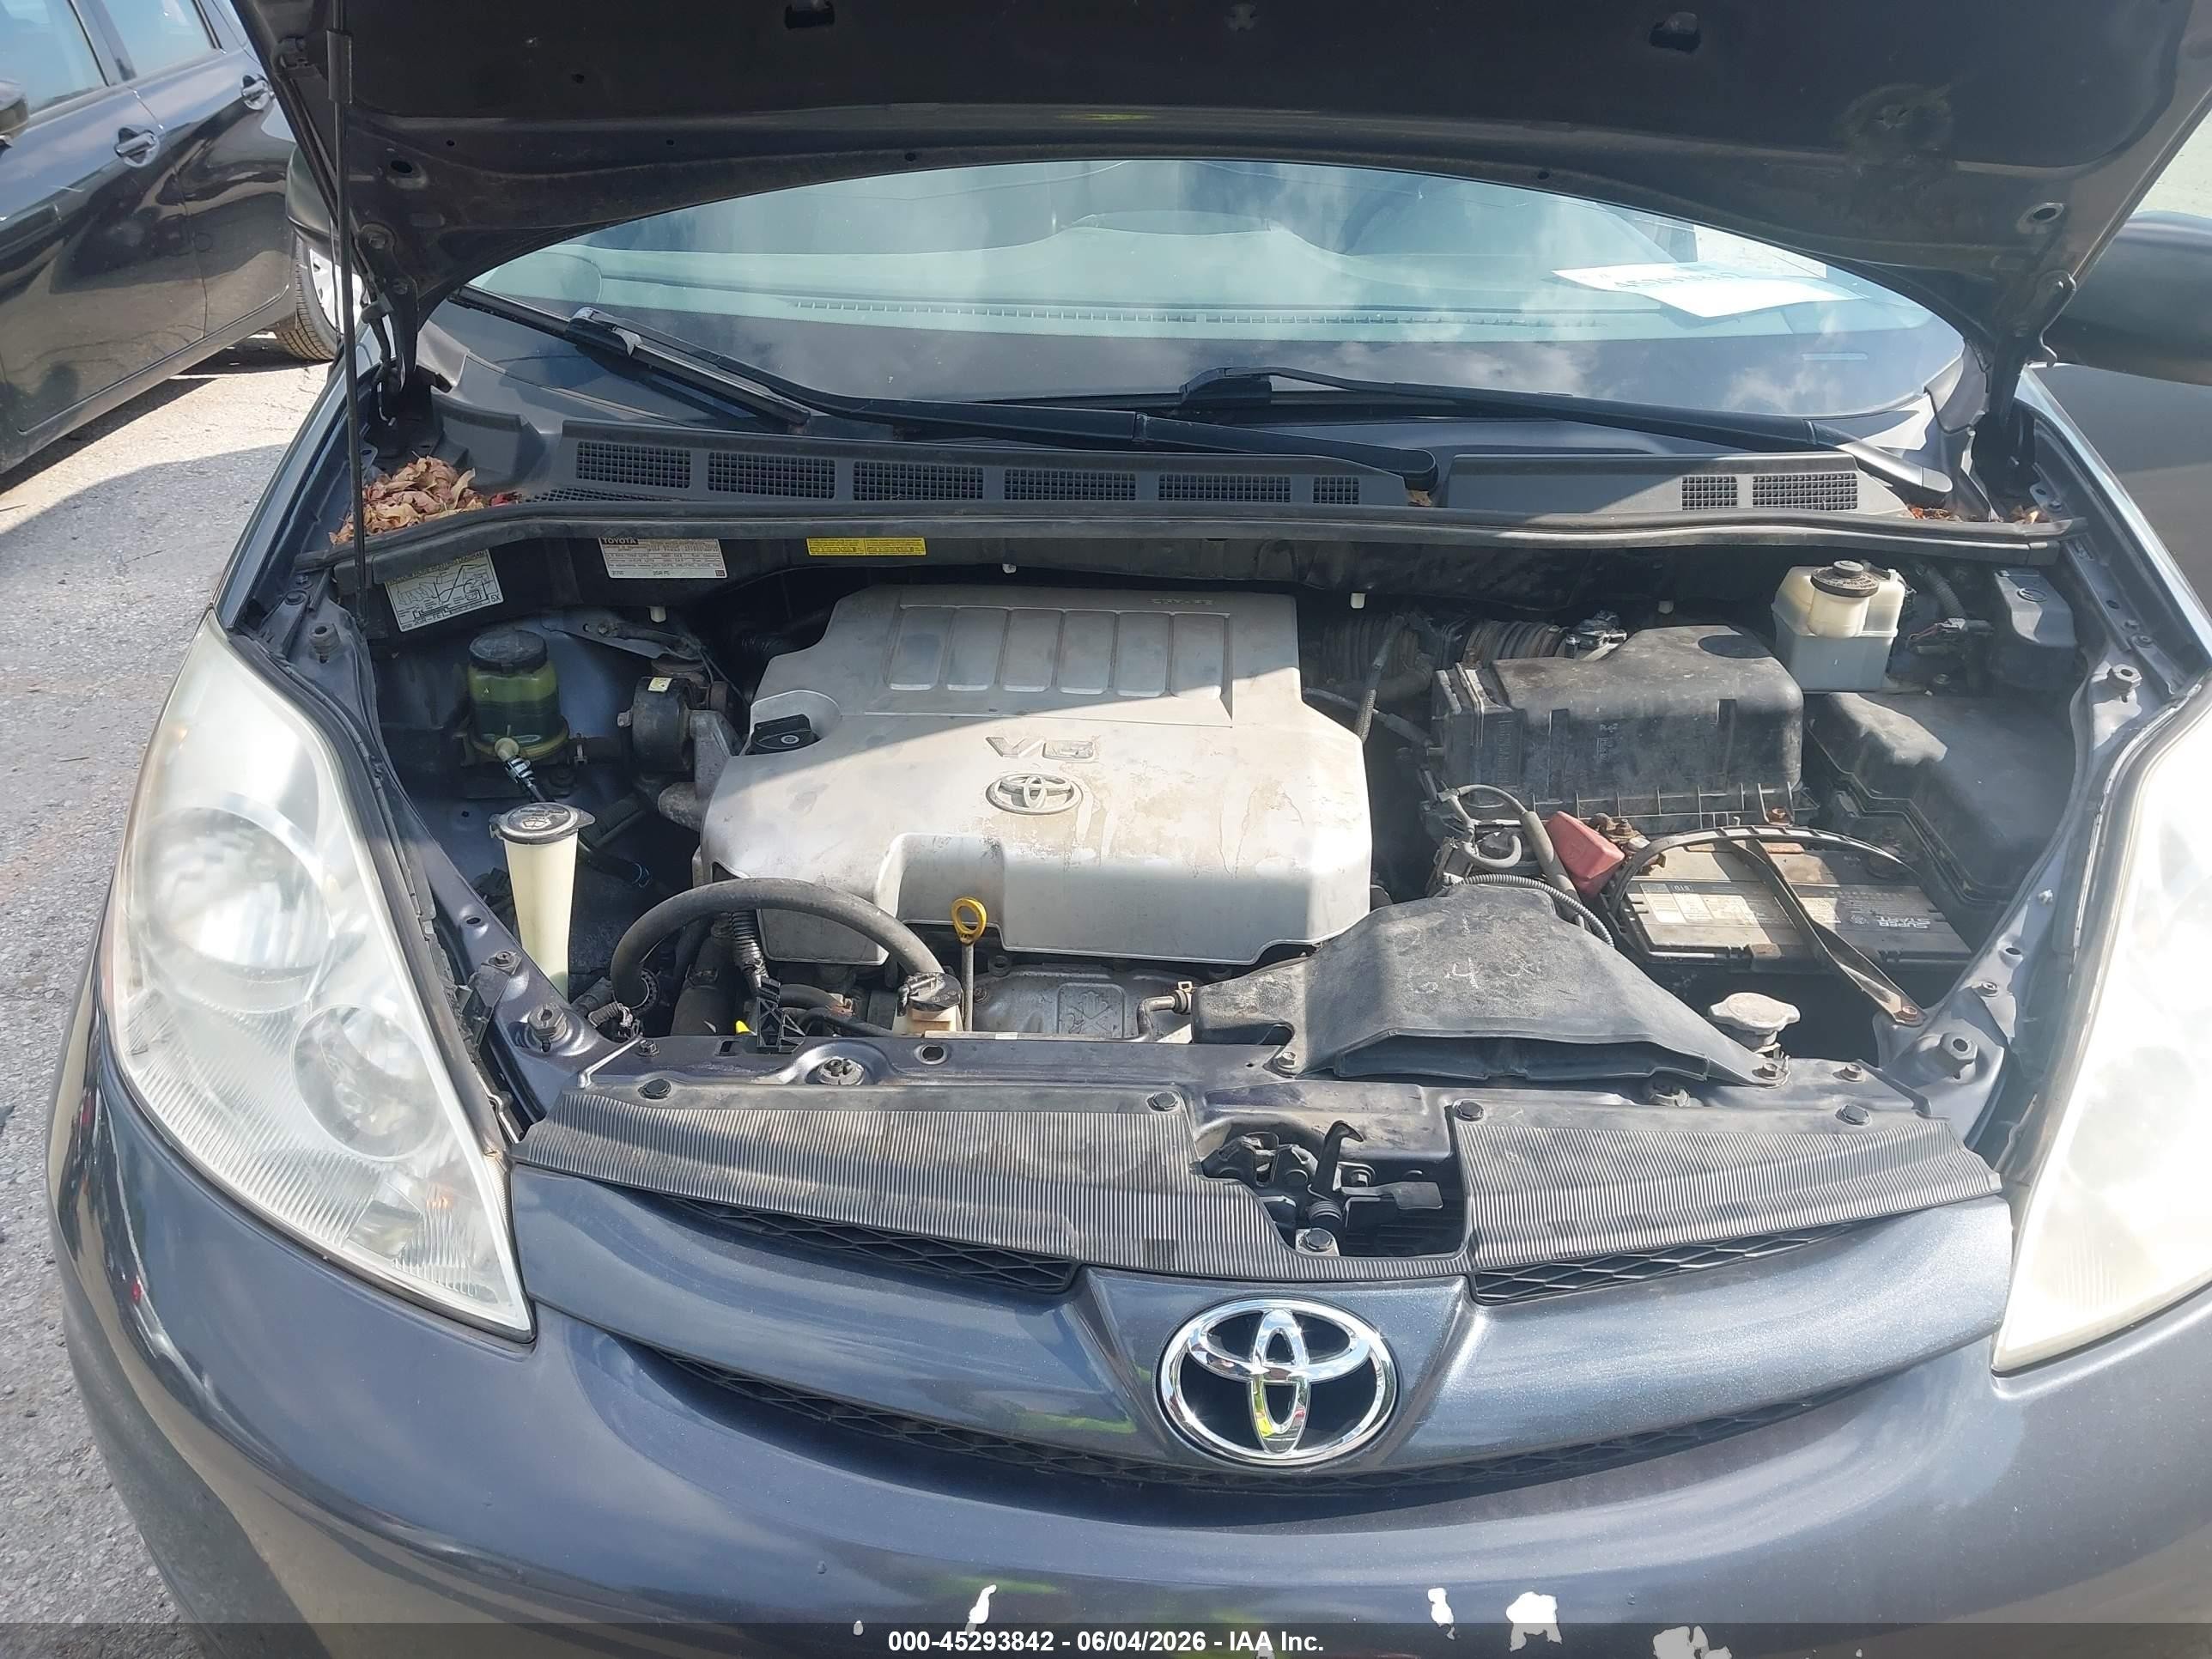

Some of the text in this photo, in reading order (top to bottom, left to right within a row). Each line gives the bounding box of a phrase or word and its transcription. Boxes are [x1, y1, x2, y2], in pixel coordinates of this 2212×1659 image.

[985, 736, 1095, 763] V6
[1875, 915, 1931, 925] START
[1878, 921, 1929, 929] SUPER
